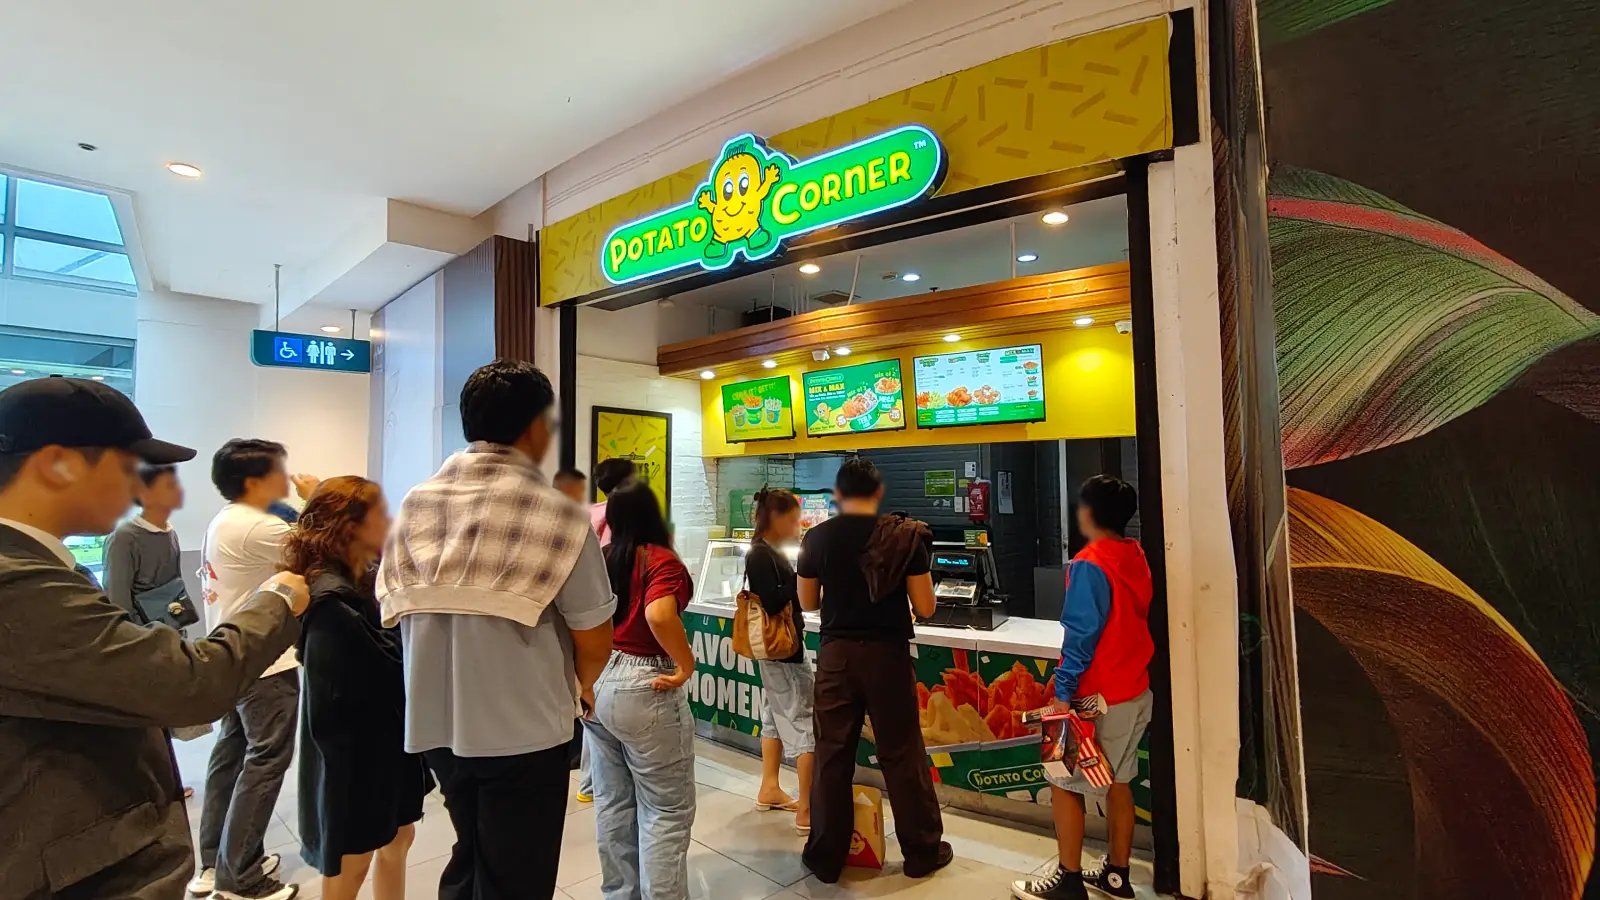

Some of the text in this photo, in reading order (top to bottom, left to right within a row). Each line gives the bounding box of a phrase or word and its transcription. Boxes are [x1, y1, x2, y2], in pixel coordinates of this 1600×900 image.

[913, 139, 927, 150] TM
[610, 151, 911, 272] POTATO CORNER
[809, 386, 823, 394] MIX
[829, 383, 845, 391] MAX
[689, 630, 756, 677] AVOR
[684, 669, 766, 721] MOMEN
[973, 768, 1046, 785] POTATO COR
